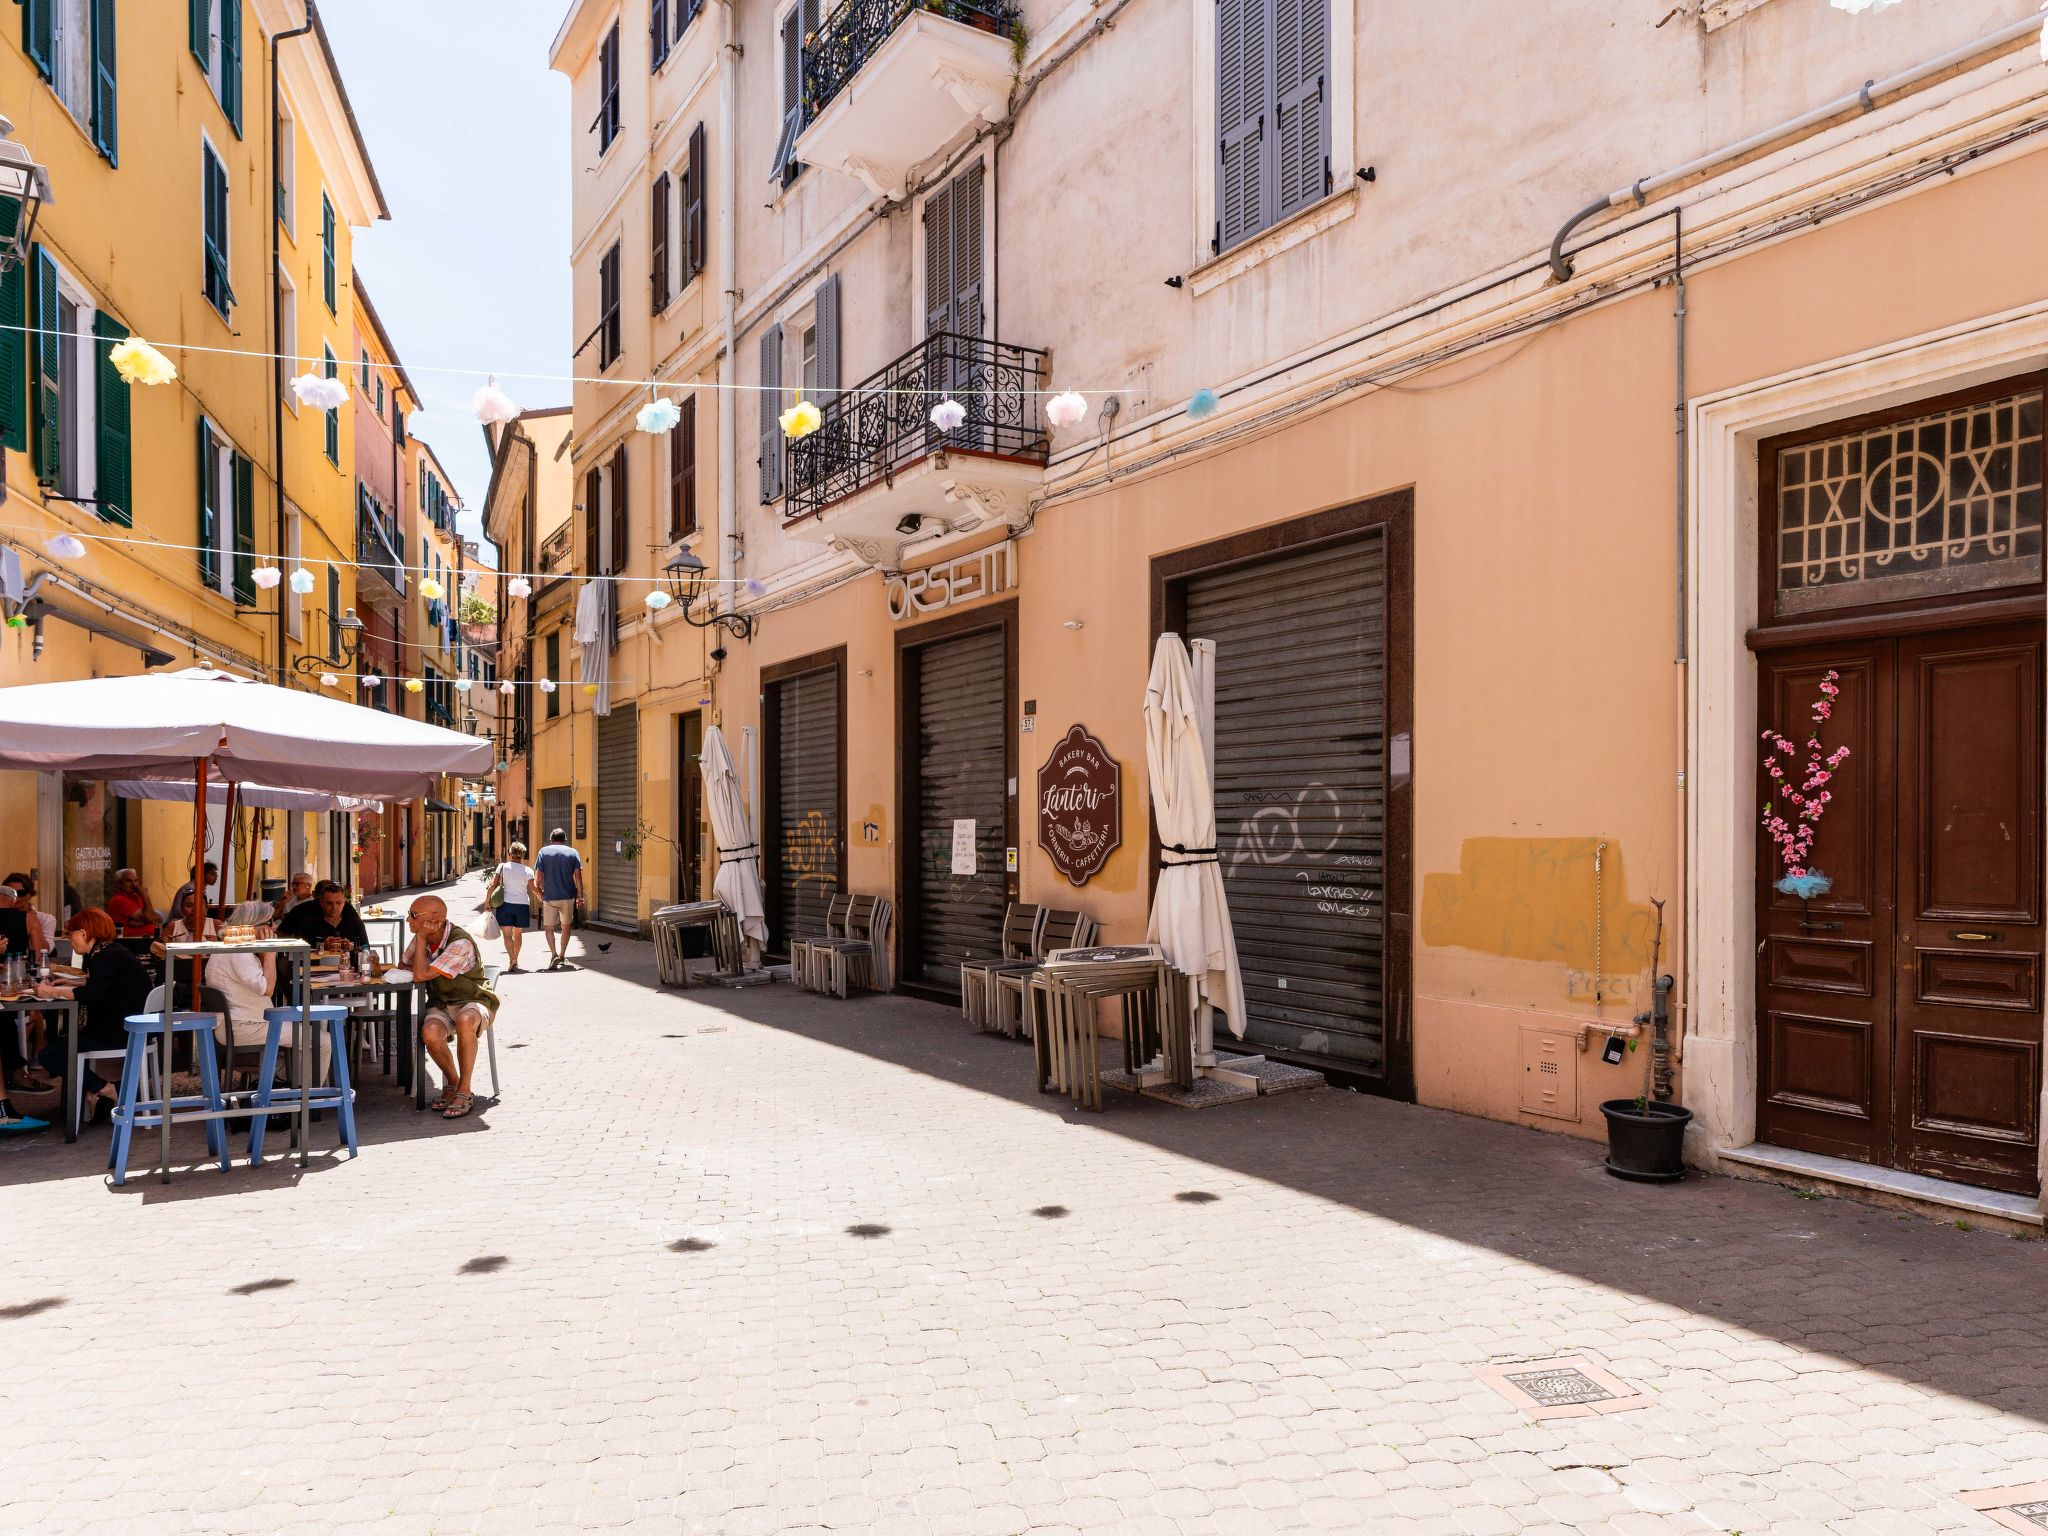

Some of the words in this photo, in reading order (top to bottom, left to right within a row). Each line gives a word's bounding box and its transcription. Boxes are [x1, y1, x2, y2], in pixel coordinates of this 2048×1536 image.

[1059, 749, 1084, 768] BAKERY
[1086, 752, 1100, 770] BAR
[1041, 782, 1115, 820] Lanteri
[75, 847, 112, 859] GASTRONOMIA
[1047, 823, 1070, 865] FORNERIA
[1075, 824, 1110, 868] CAFFETTERIA
